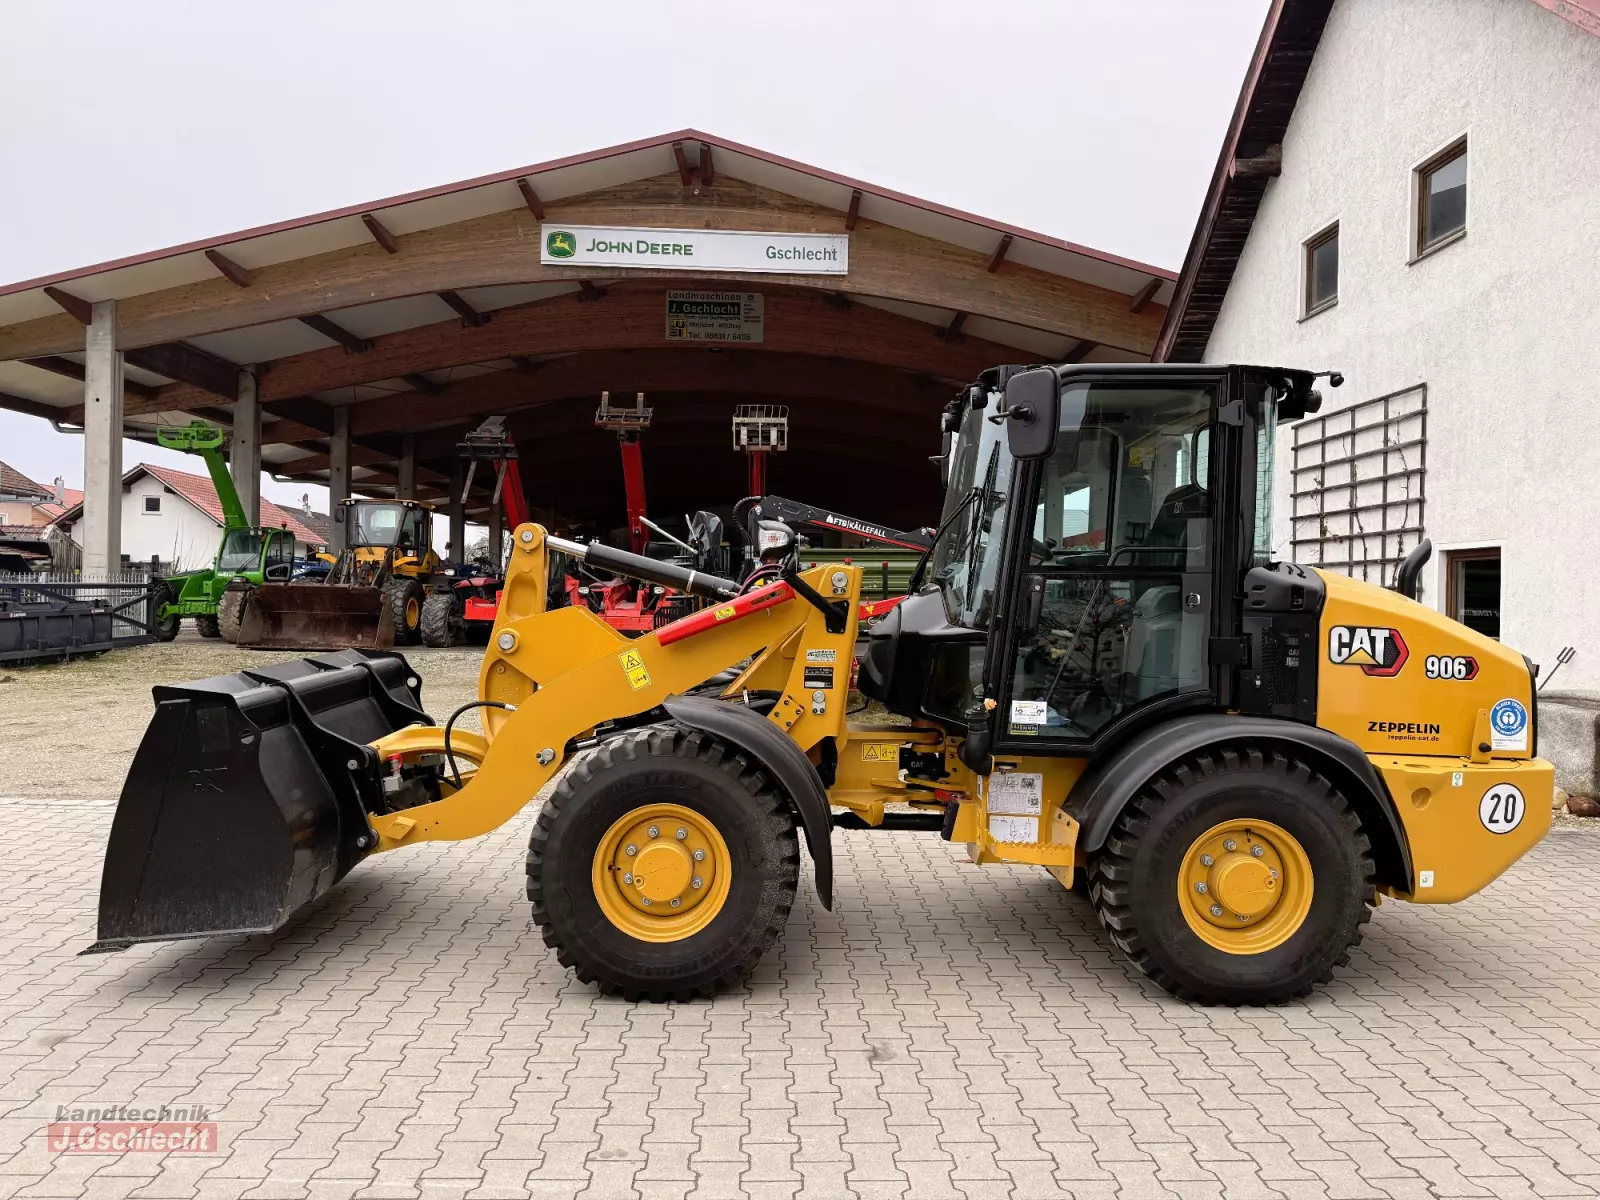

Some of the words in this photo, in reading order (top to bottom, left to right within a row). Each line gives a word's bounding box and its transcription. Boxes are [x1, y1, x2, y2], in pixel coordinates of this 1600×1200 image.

[586, 238, 633, 254] JOHN
[636, 241, 694, 256] DEERE
[766, 245, 838, 262] Gschlecht
[668, 290, 741, 301] Landmaschinen
[670, 303, 680, 312] J.
[683, 303, 739, 314] Gschlecht
[689, 331, 703, 339] Tel.
[1329, 625, 1390, 666] CAT
[1425, 655, 1467, 679] 906
[1368, 721, 1440, 734] ZEPPELIN
[1388, 734, 1440, 742] zeppelin-cat.de
[1488, 793, 1517, 824] 20
